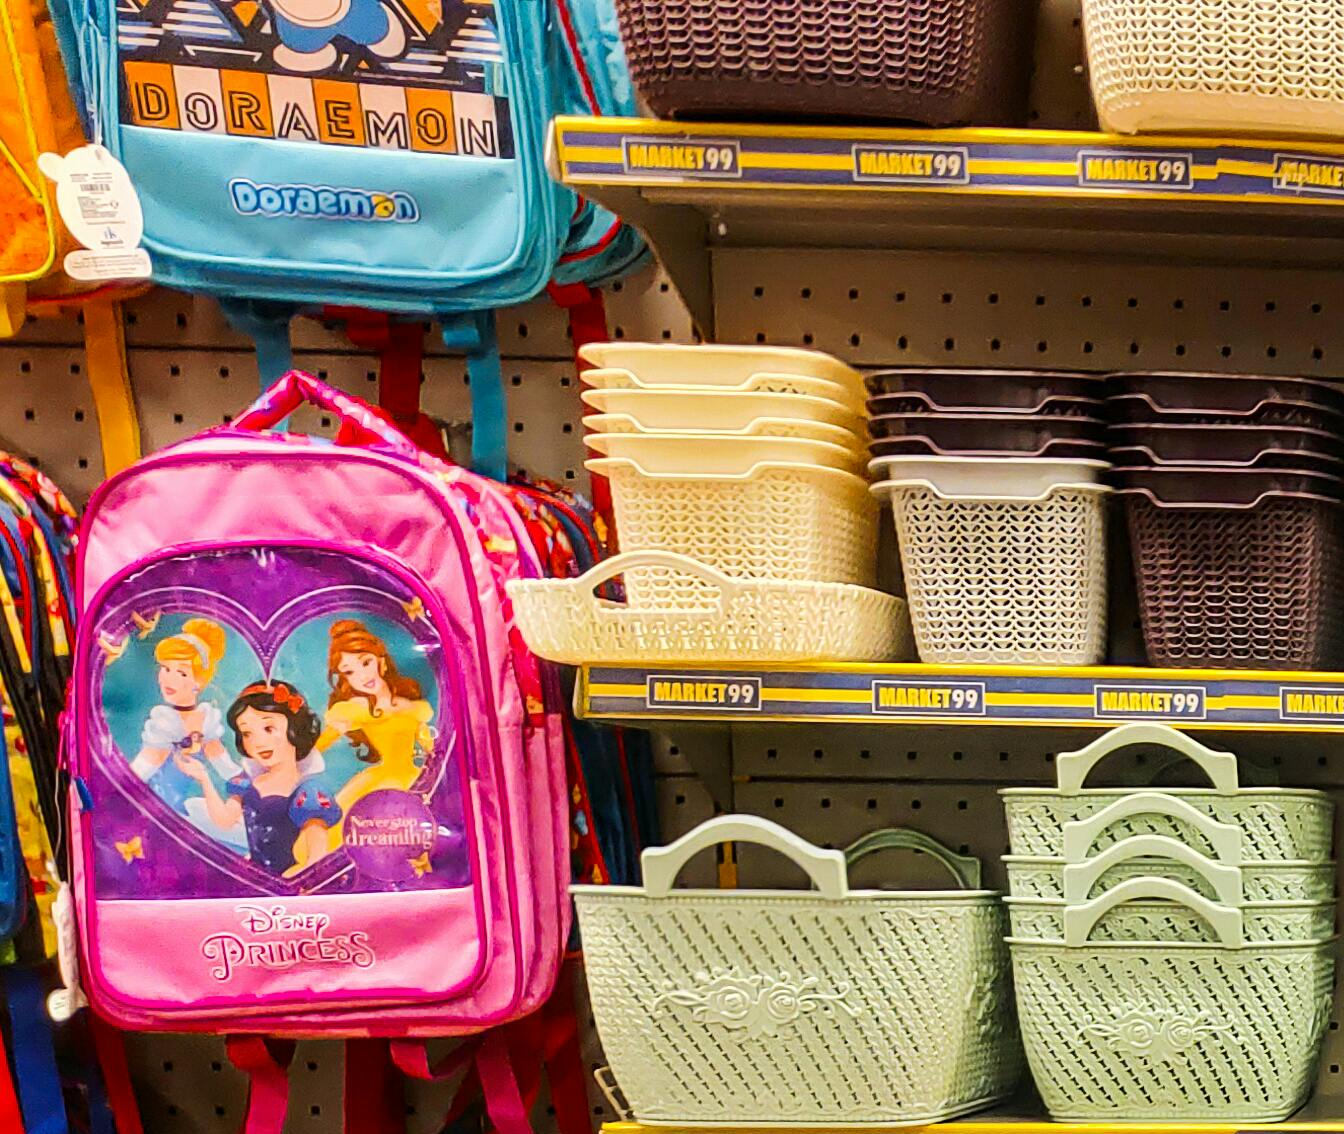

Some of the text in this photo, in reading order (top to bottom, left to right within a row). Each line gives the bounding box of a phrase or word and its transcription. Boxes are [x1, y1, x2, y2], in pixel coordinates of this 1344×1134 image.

[134, 82, 496, 158] DORAEMON
[629, 143, 734, 172] MARKET99
[860, 150, 961, 177] MARKET99
[1086, 157, 1185, 182] MARKET99
[233, 181, 418, 220] Doraemon
[653, 681, 754, 705] MARKET99
[879, 686, 978, 710] MARKET99
[1101, 691, 1199, 714] MARKET99
